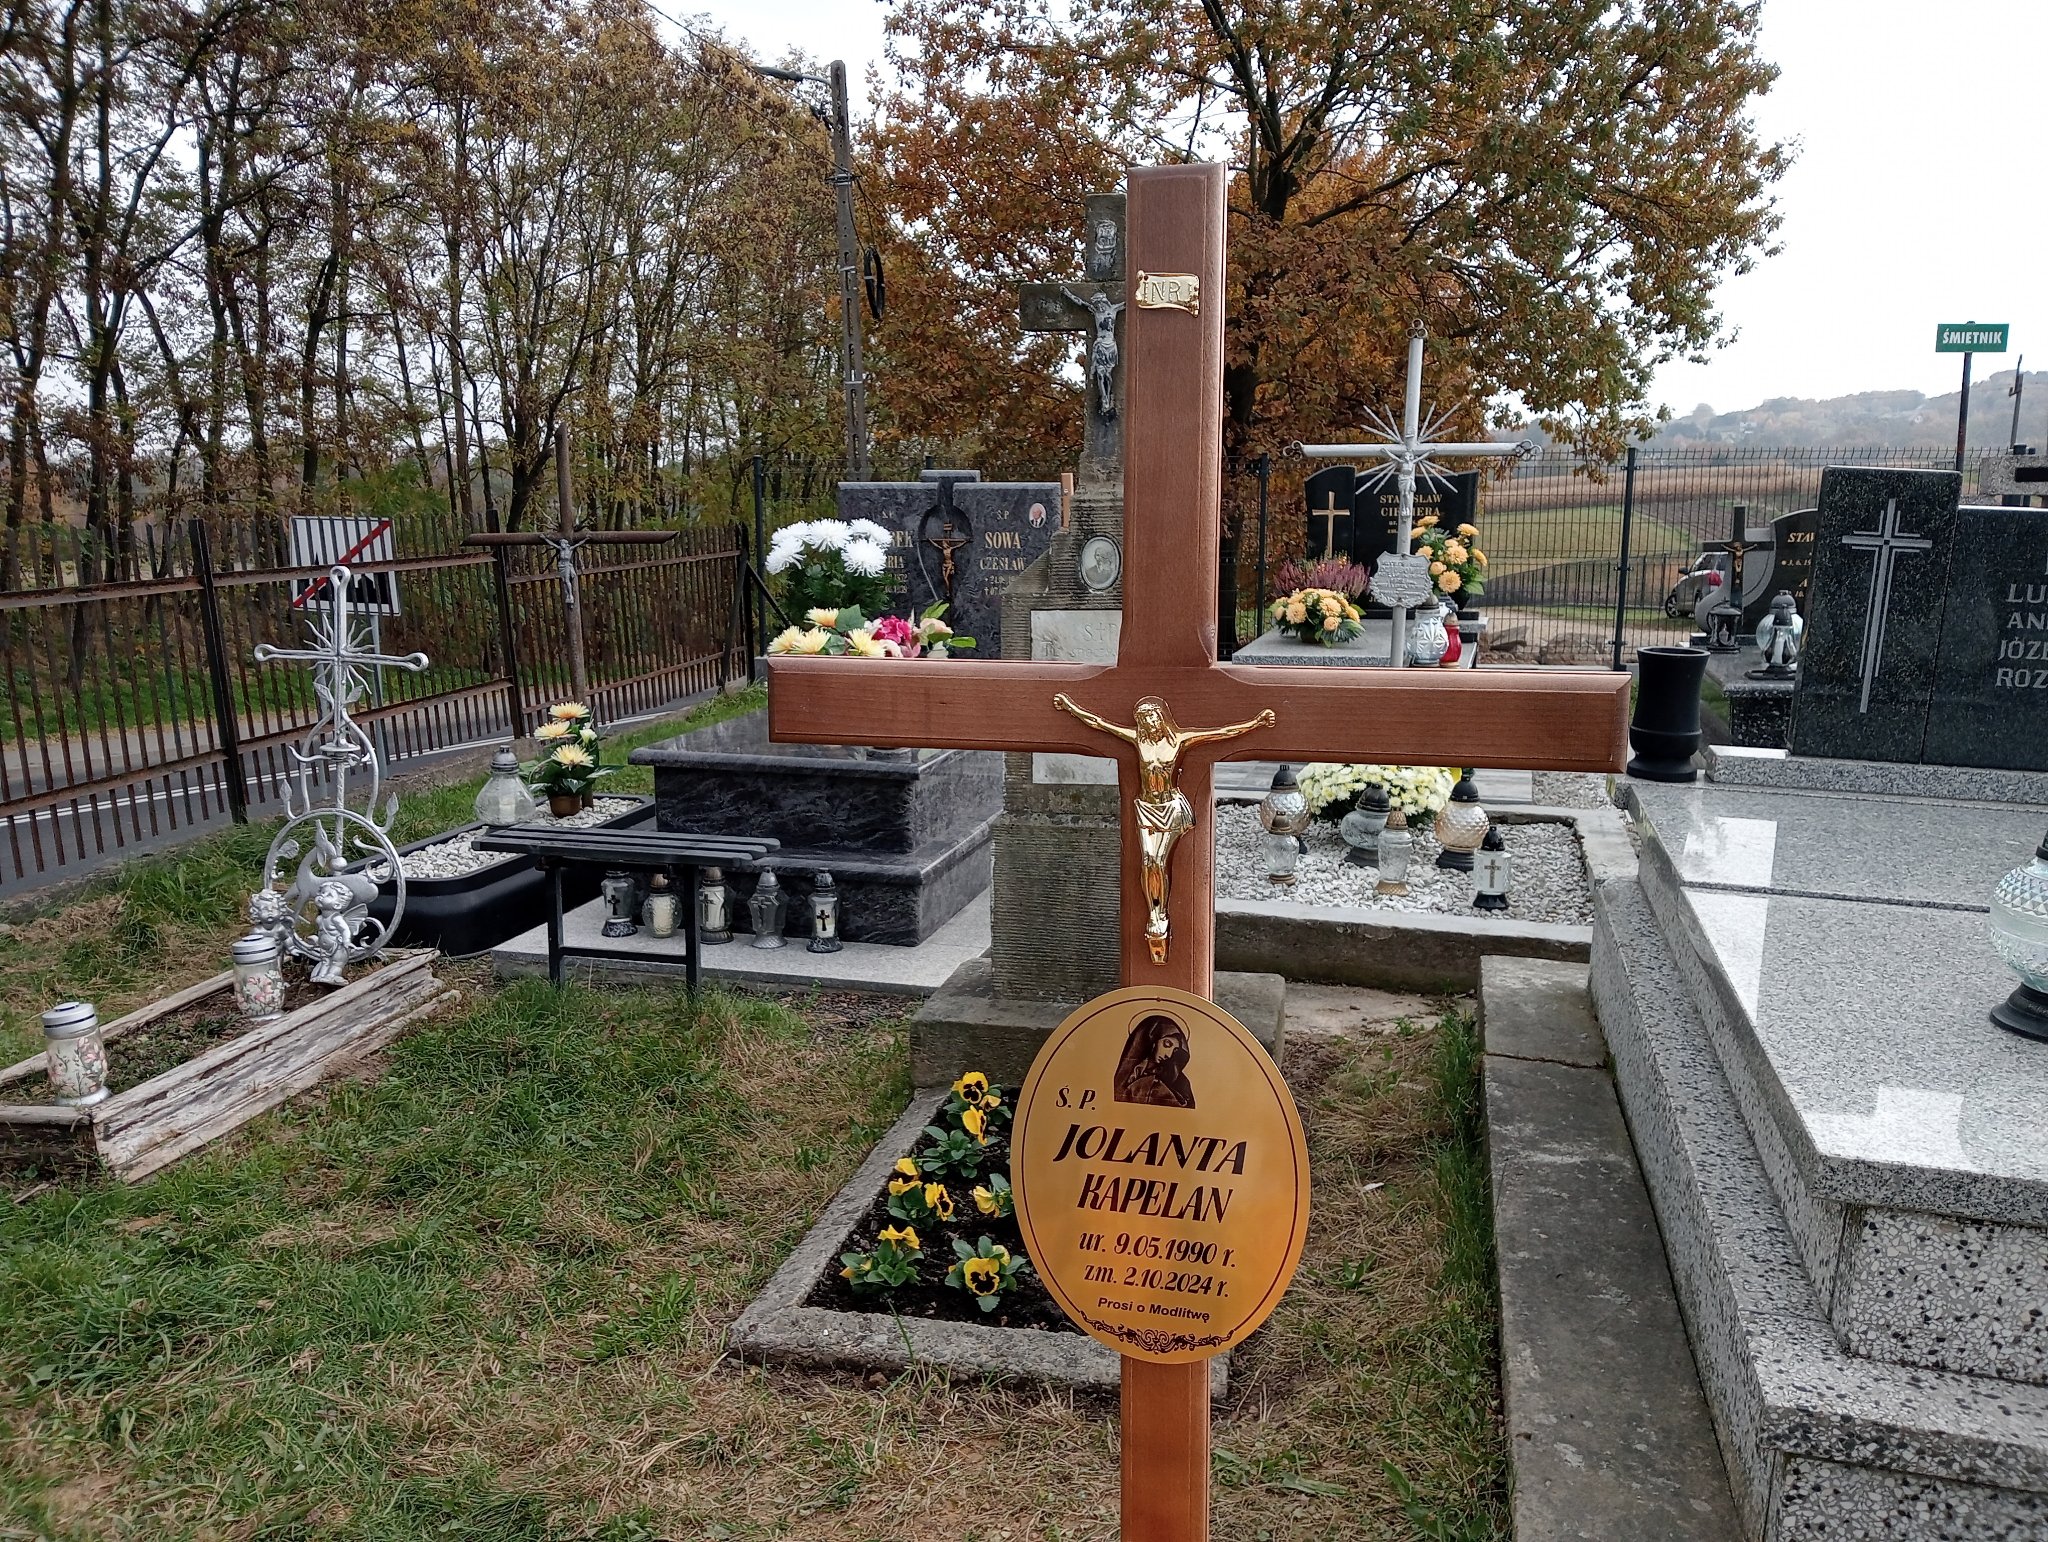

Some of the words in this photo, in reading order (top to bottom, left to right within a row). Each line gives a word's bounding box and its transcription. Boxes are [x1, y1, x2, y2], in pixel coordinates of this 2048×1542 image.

[1942, 328, 2002, 344] ŚMIETNIK
[984, 531, 1021, 549] SOWA
[2005, 583, 2048, 603] LU
[2006, 612, 2048, 630] AN
[1055, 1083, 1072, 1108] Ś.
[1078, 1089, 1096, 1111] P.
[1052, 1123, 1248, 1176] JOLANTA
[1076, 1173, 1234, 1223] KAPELAN
[1079, 1232, 1106, 1253] ur.
[1113, 1232, 1218, 1265] 9.05.1990
[1221, 1247, 1237, 1268] r.
[1084, 1264, 1118, 1284] zm.
[1123, 1266, 1214, 1295] 2.10.2024
[1216, 1280, 1229, 1298] r.
[1097, 1297, 1133, 1311] Prosi
[1136, 1303, 1146, 1313] o
[1148, 1304, 1211, 1323] Modlitwę
